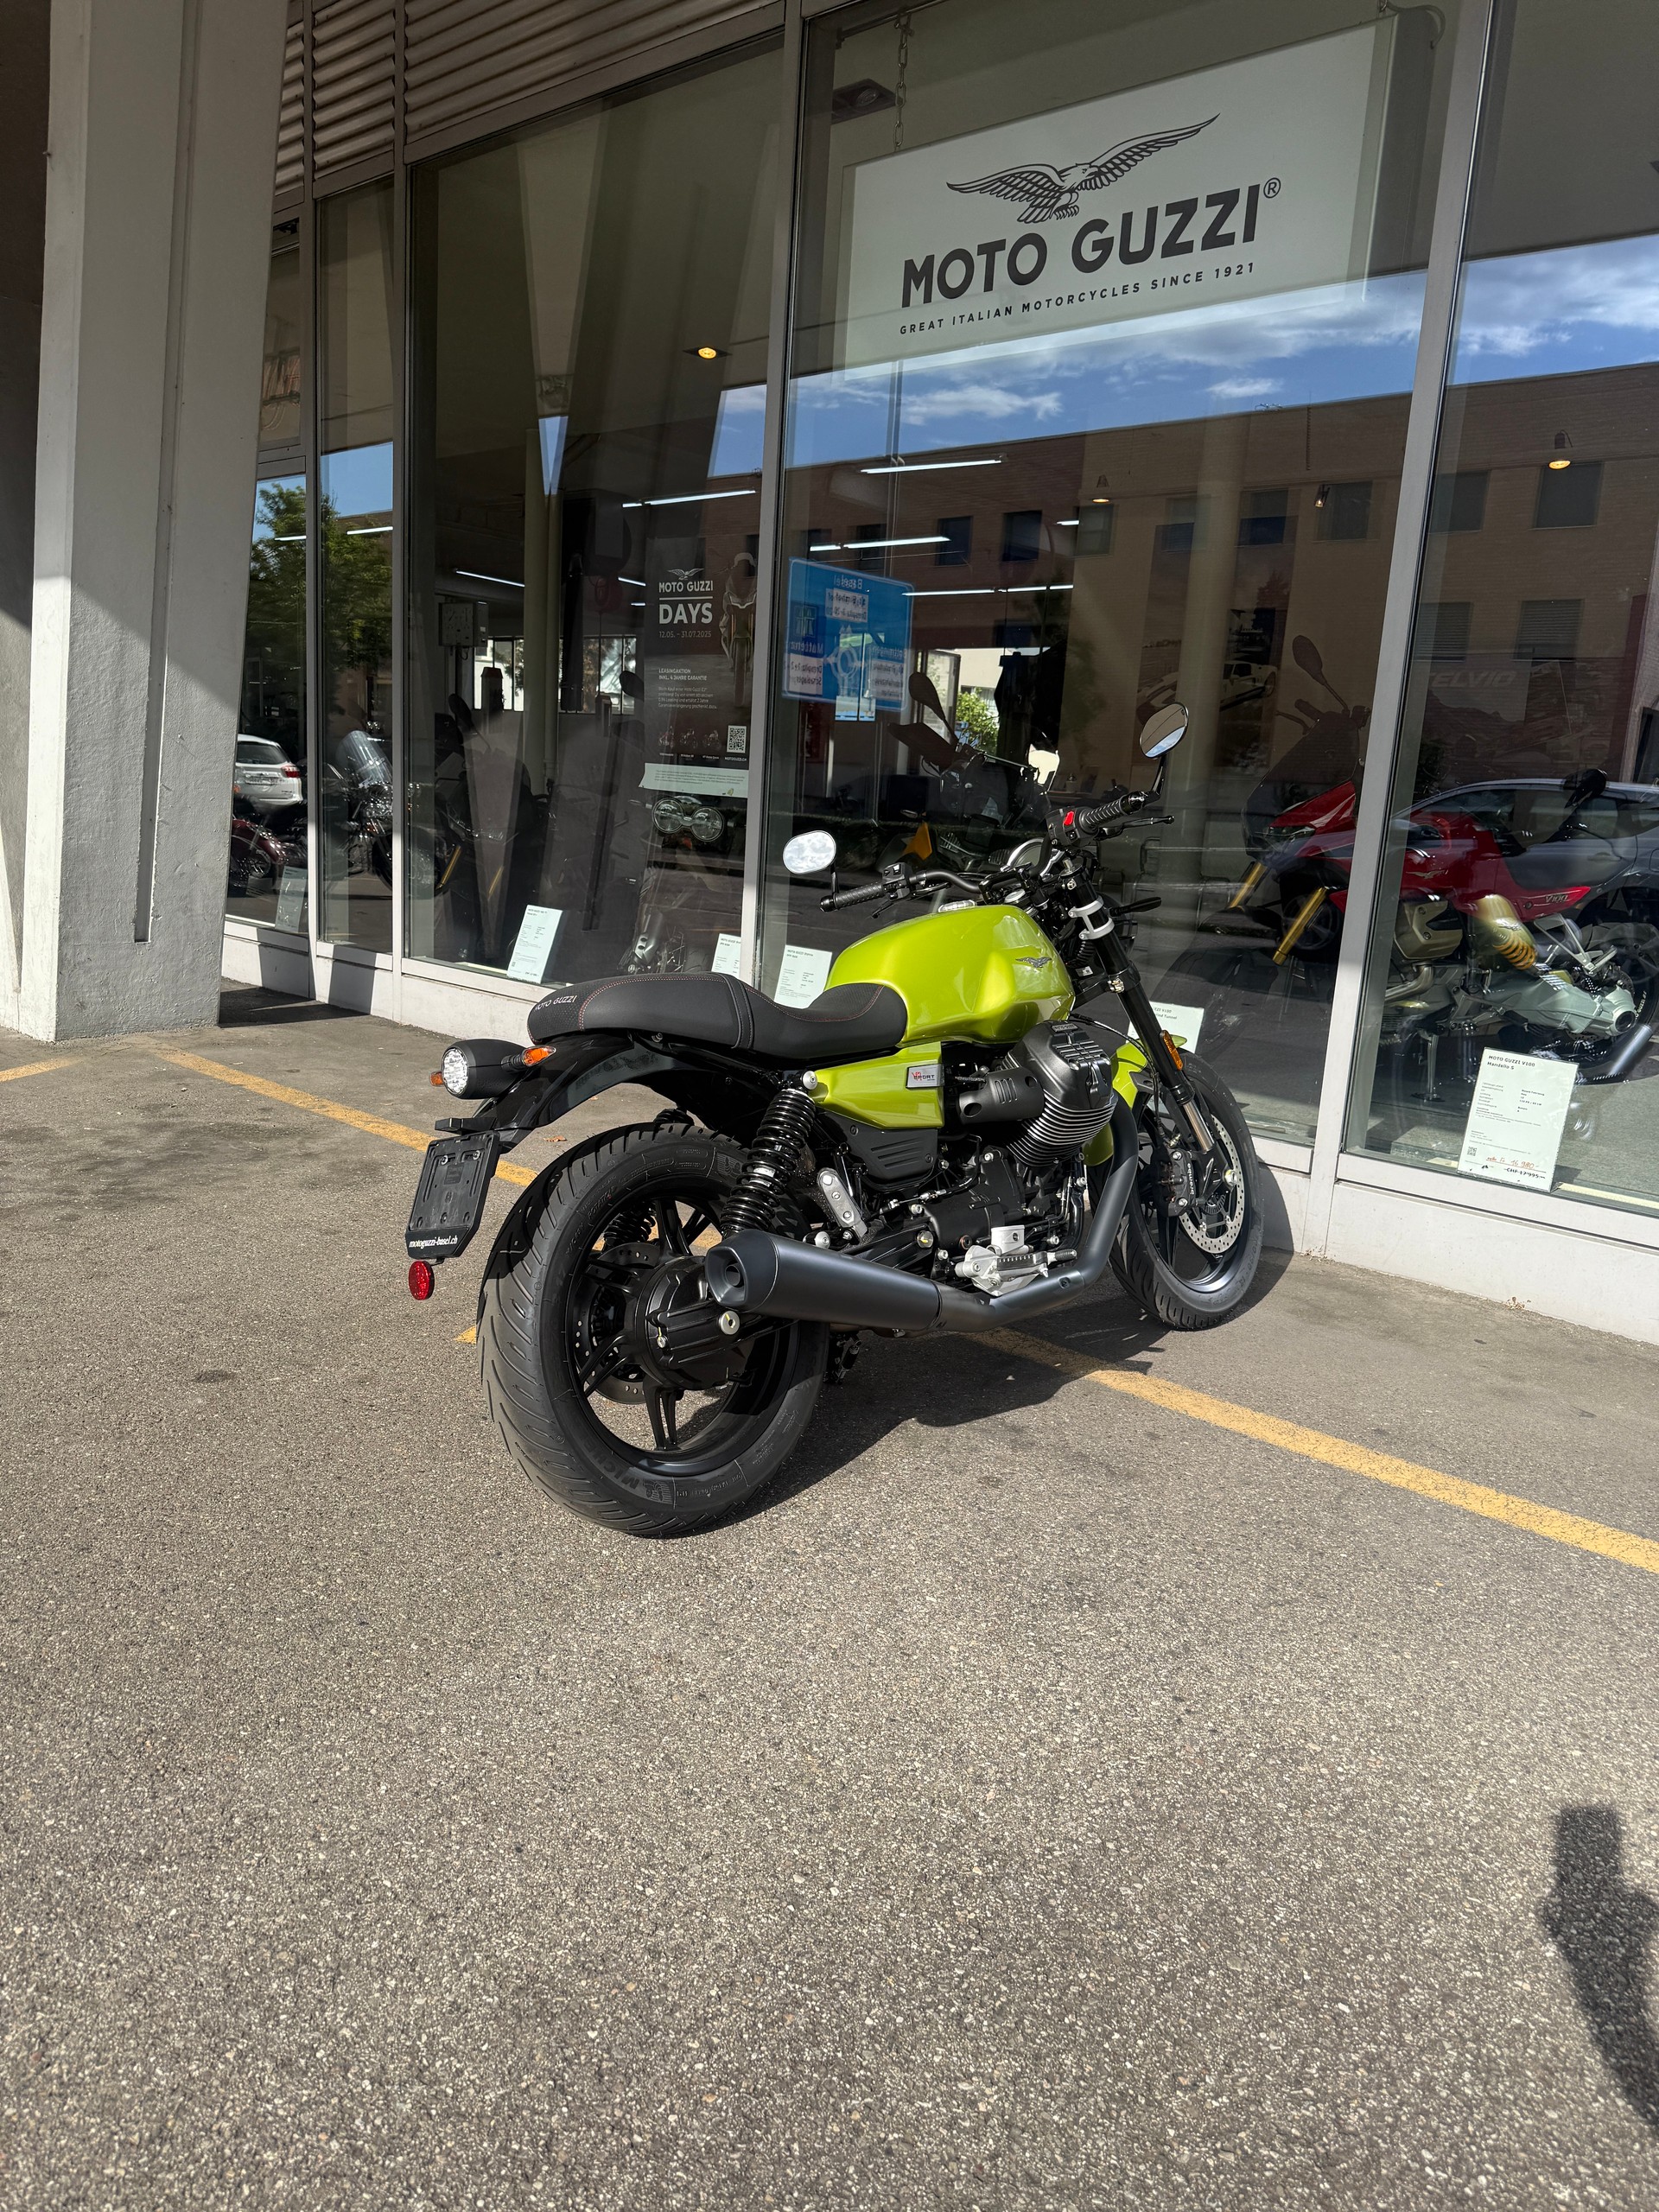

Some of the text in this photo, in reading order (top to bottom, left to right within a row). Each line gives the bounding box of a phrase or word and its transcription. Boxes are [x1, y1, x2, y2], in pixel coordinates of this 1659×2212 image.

[901, 232, 1048, 308] MOTO
[899, 262, 1255, 335] GREAT ITALIAN MOTORCYCLES SINCE 1921
[658, 580, 714, 593] MOTO GUZZI
[658, 602, 713, 624] DAYS
[553, 995, 577, 1005] GUZZI
[409, 1235, 458, 1249] motoguzzi-basel.ch
